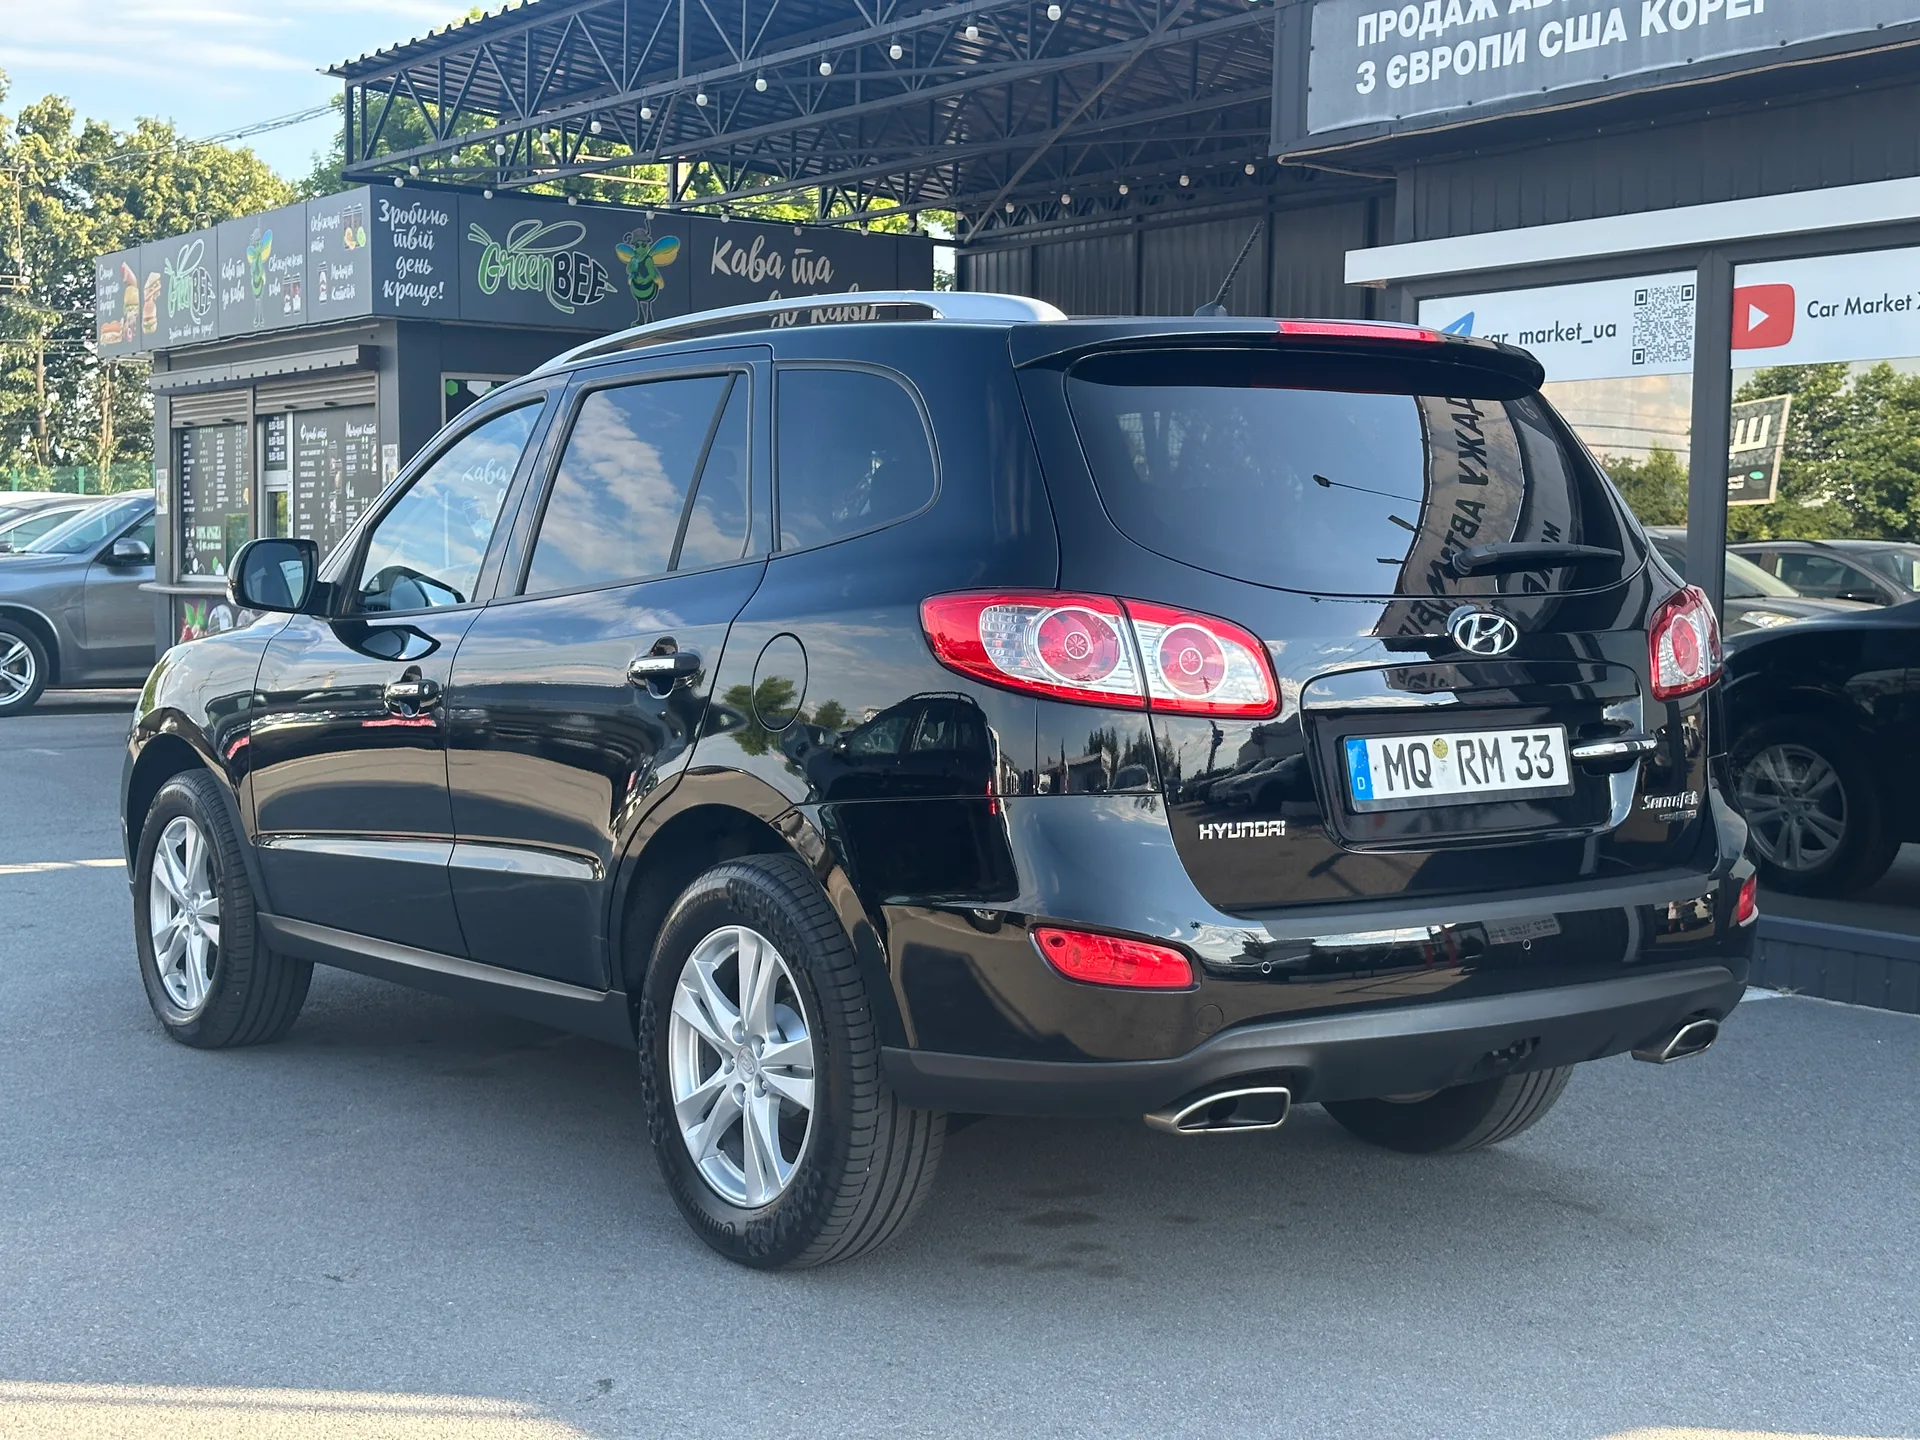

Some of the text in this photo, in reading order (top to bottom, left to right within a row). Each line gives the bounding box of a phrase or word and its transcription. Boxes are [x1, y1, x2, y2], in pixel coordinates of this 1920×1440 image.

[1357, 0, 1499, 47] ПРОДАЖ
[1356, 61, 1376, 94] З
[1386, 28, 1527, 89] ЄВРОПИ
[1538, 8, 1628, 58] США
[379, 199, 450, 231] Зробимо
[394, 225, 435, 251] твій
[395, 256, 433, 280] день
[711, 235, 835, 285] Кава та
[382, 280, 445, 307] краще!
[478, 241, 610, 314] GreenBEE
[1807, 300, 1839, 318] Car
[1844, 293, 1912, 316] Market
[1356, 734, 1555, 791] D MQ RM 33
[1198, 820, 1287, 840] HYUNDAI
